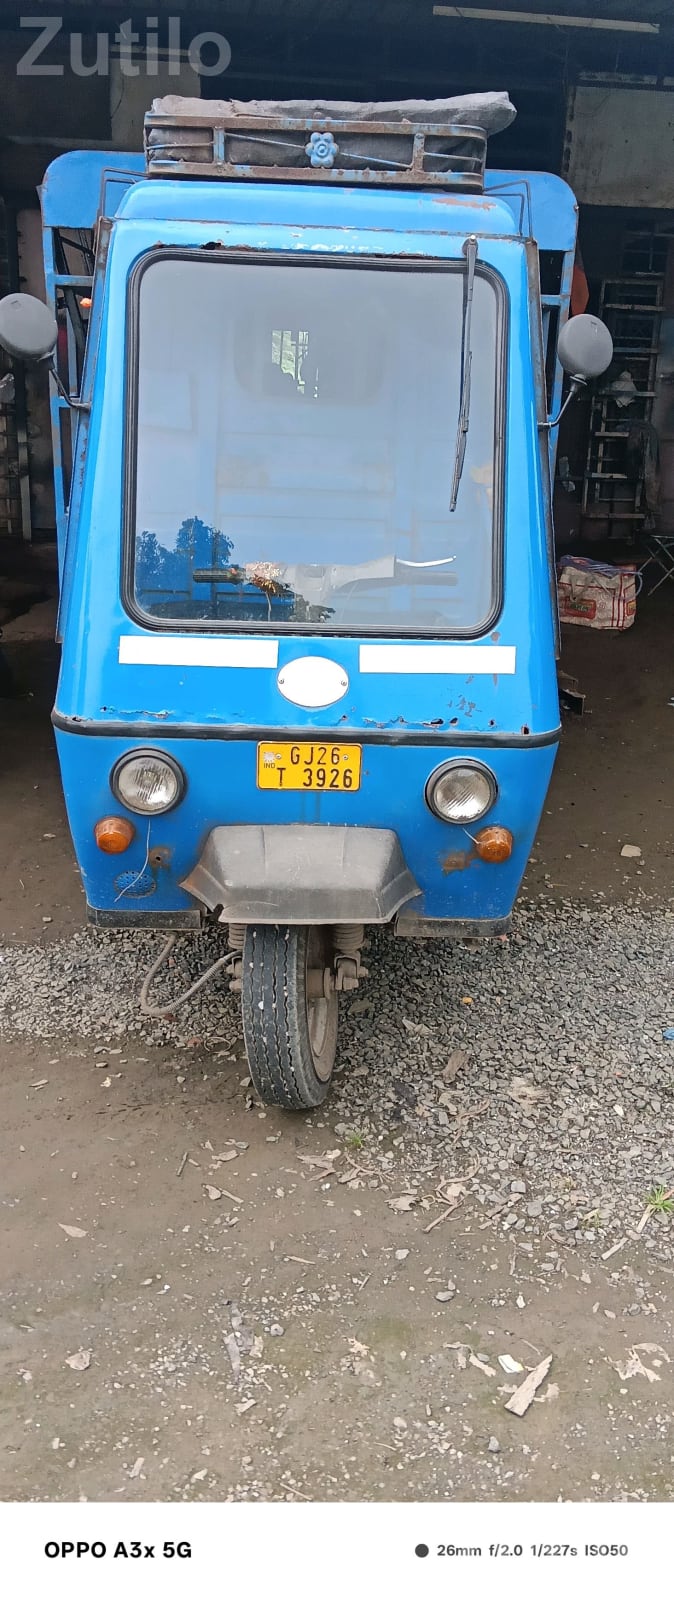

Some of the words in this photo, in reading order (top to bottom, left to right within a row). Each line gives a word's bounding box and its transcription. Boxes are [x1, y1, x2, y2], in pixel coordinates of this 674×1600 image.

[290, 746, 340, 765] GJ26
[276, 767, 287, 787] T
[302, 767, 353, 788] 3926
